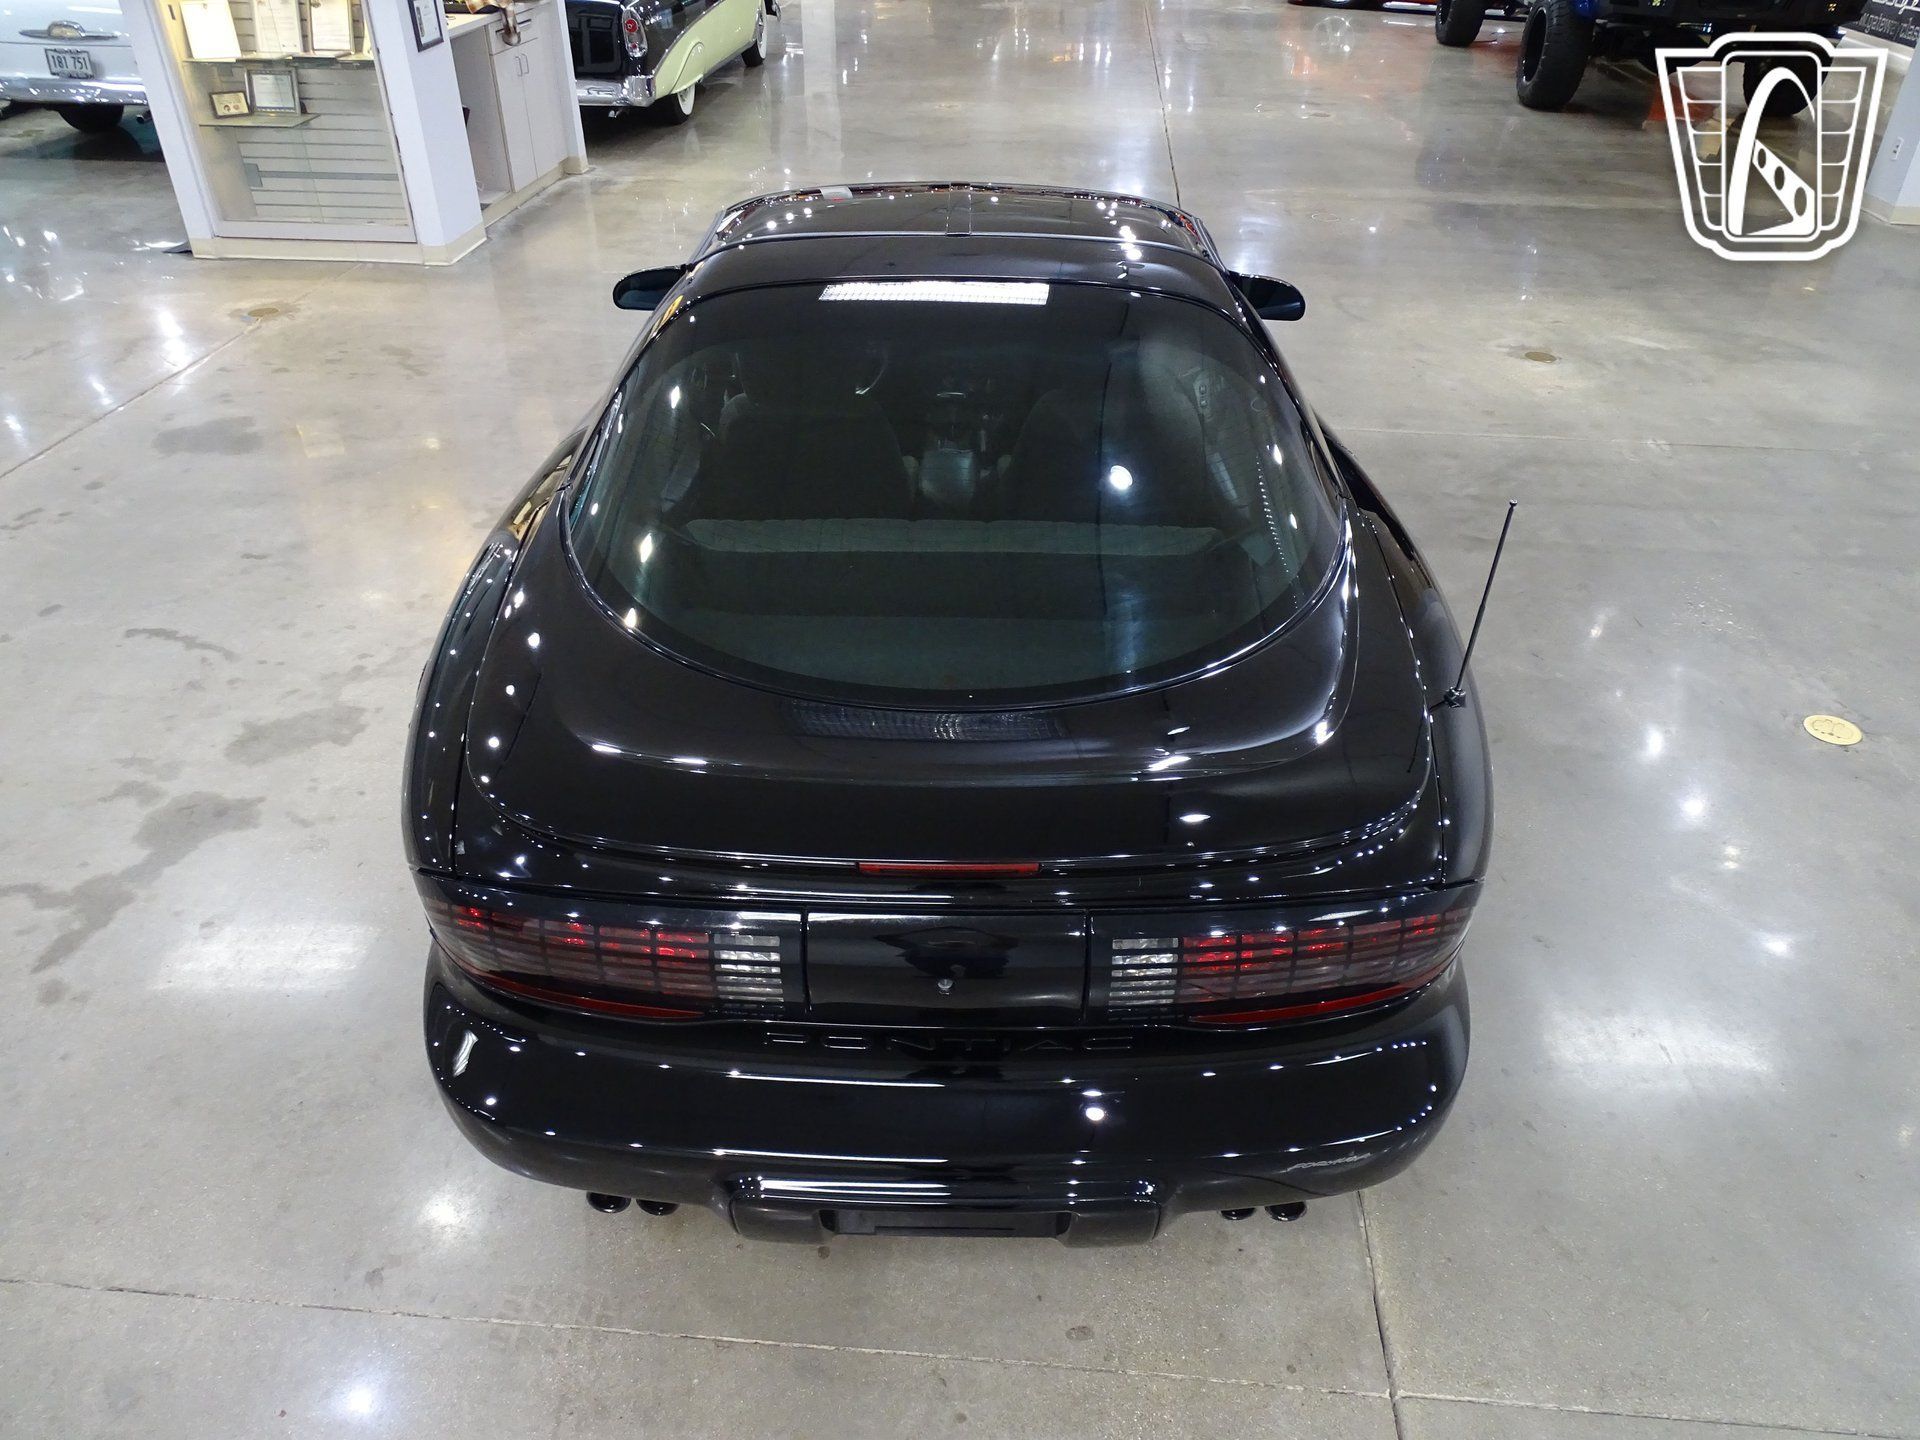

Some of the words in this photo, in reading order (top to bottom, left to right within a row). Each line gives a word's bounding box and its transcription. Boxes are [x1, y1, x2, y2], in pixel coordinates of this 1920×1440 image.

[51, 55, 69, 69] 181
[71, 56, 88, 70] 751
[764, 1031, 1134, 1052] PONTIAC
